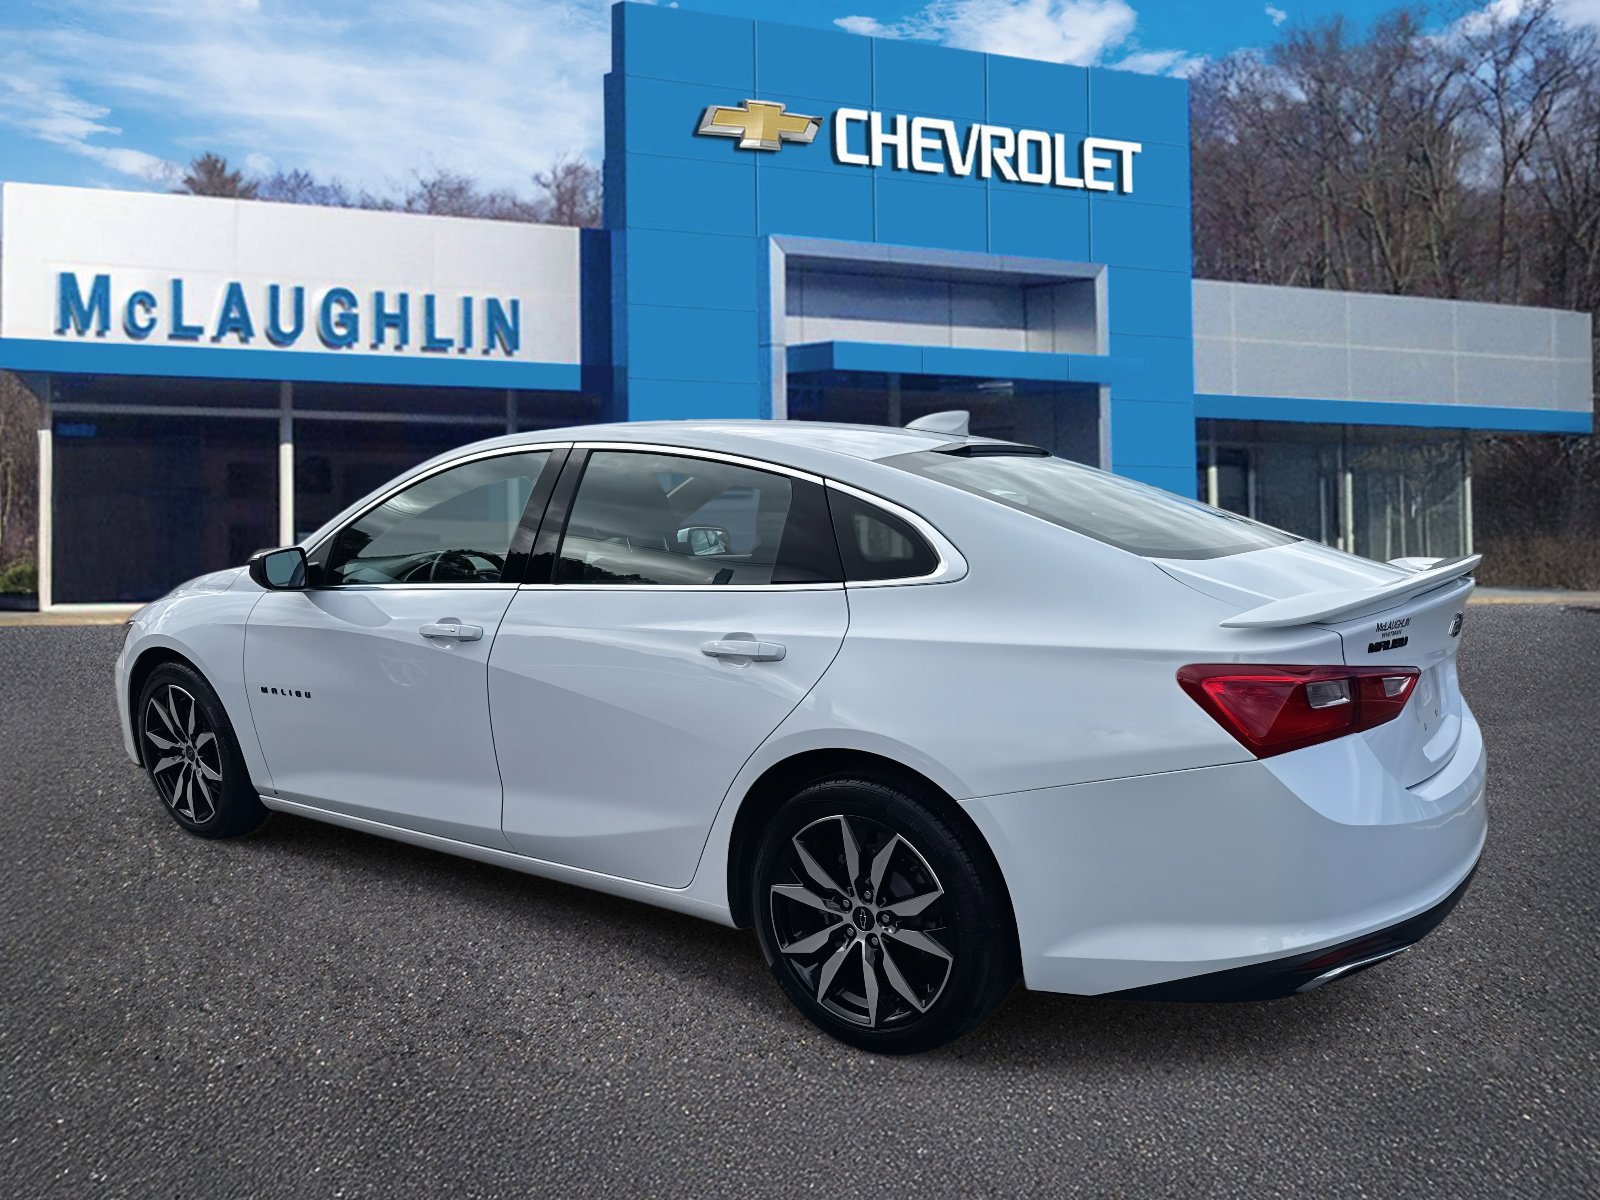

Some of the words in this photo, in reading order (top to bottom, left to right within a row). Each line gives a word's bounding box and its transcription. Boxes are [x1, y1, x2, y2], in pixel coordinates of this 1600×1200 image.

[834, 107, 1142, 194] CHEVROLET
[55, 271, 521, 357] McLAUGHLIN
[1367, 636, 1409, 654] MALIBU
[260, 686, 311, 699] MALIBU
